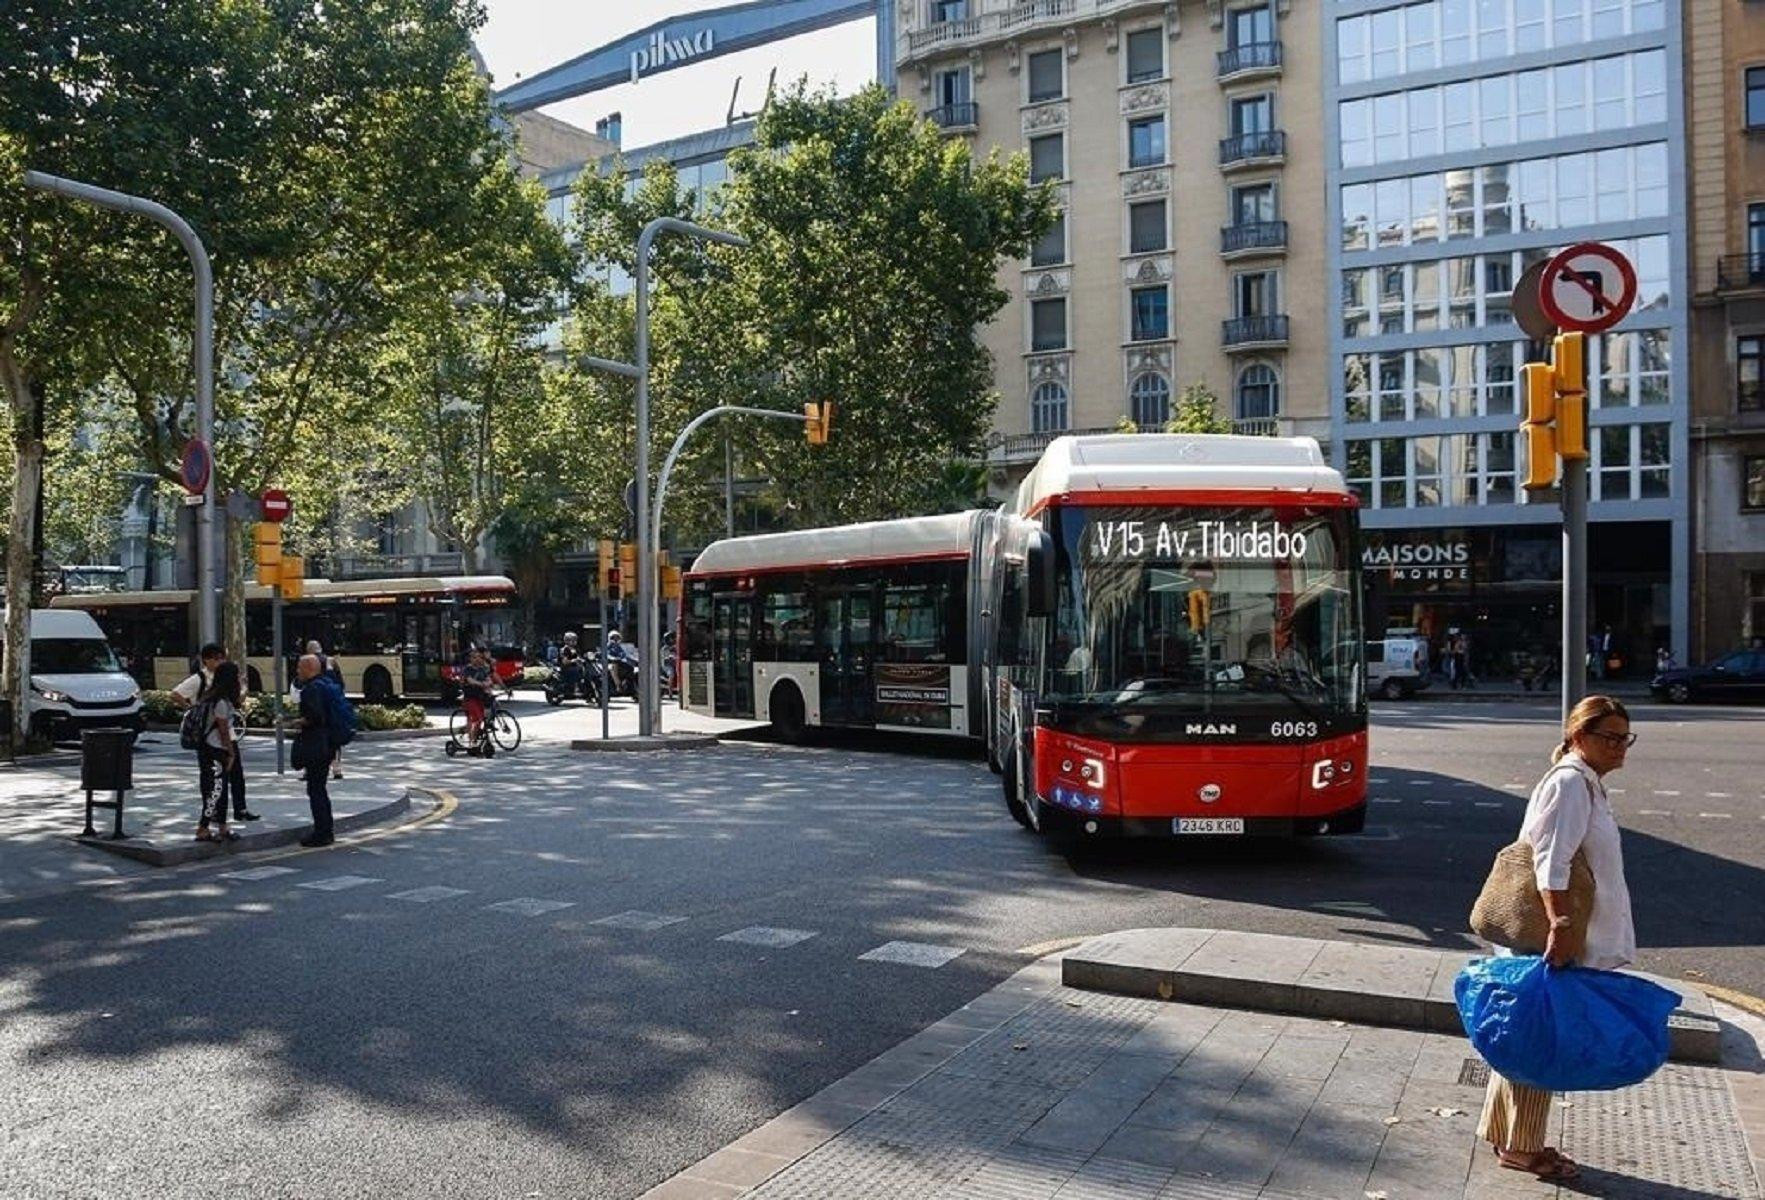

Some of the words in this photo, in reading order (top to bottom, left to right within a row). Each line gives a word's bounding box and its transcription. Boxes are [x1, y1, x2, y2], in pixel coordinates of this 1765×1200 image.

[631, 29, 713, 84] pilma
[1186, 724, 1237, 735] MAN
[1271, 722, 1318, 737] 6063
[1181, 820, 1213, 832] 2346
